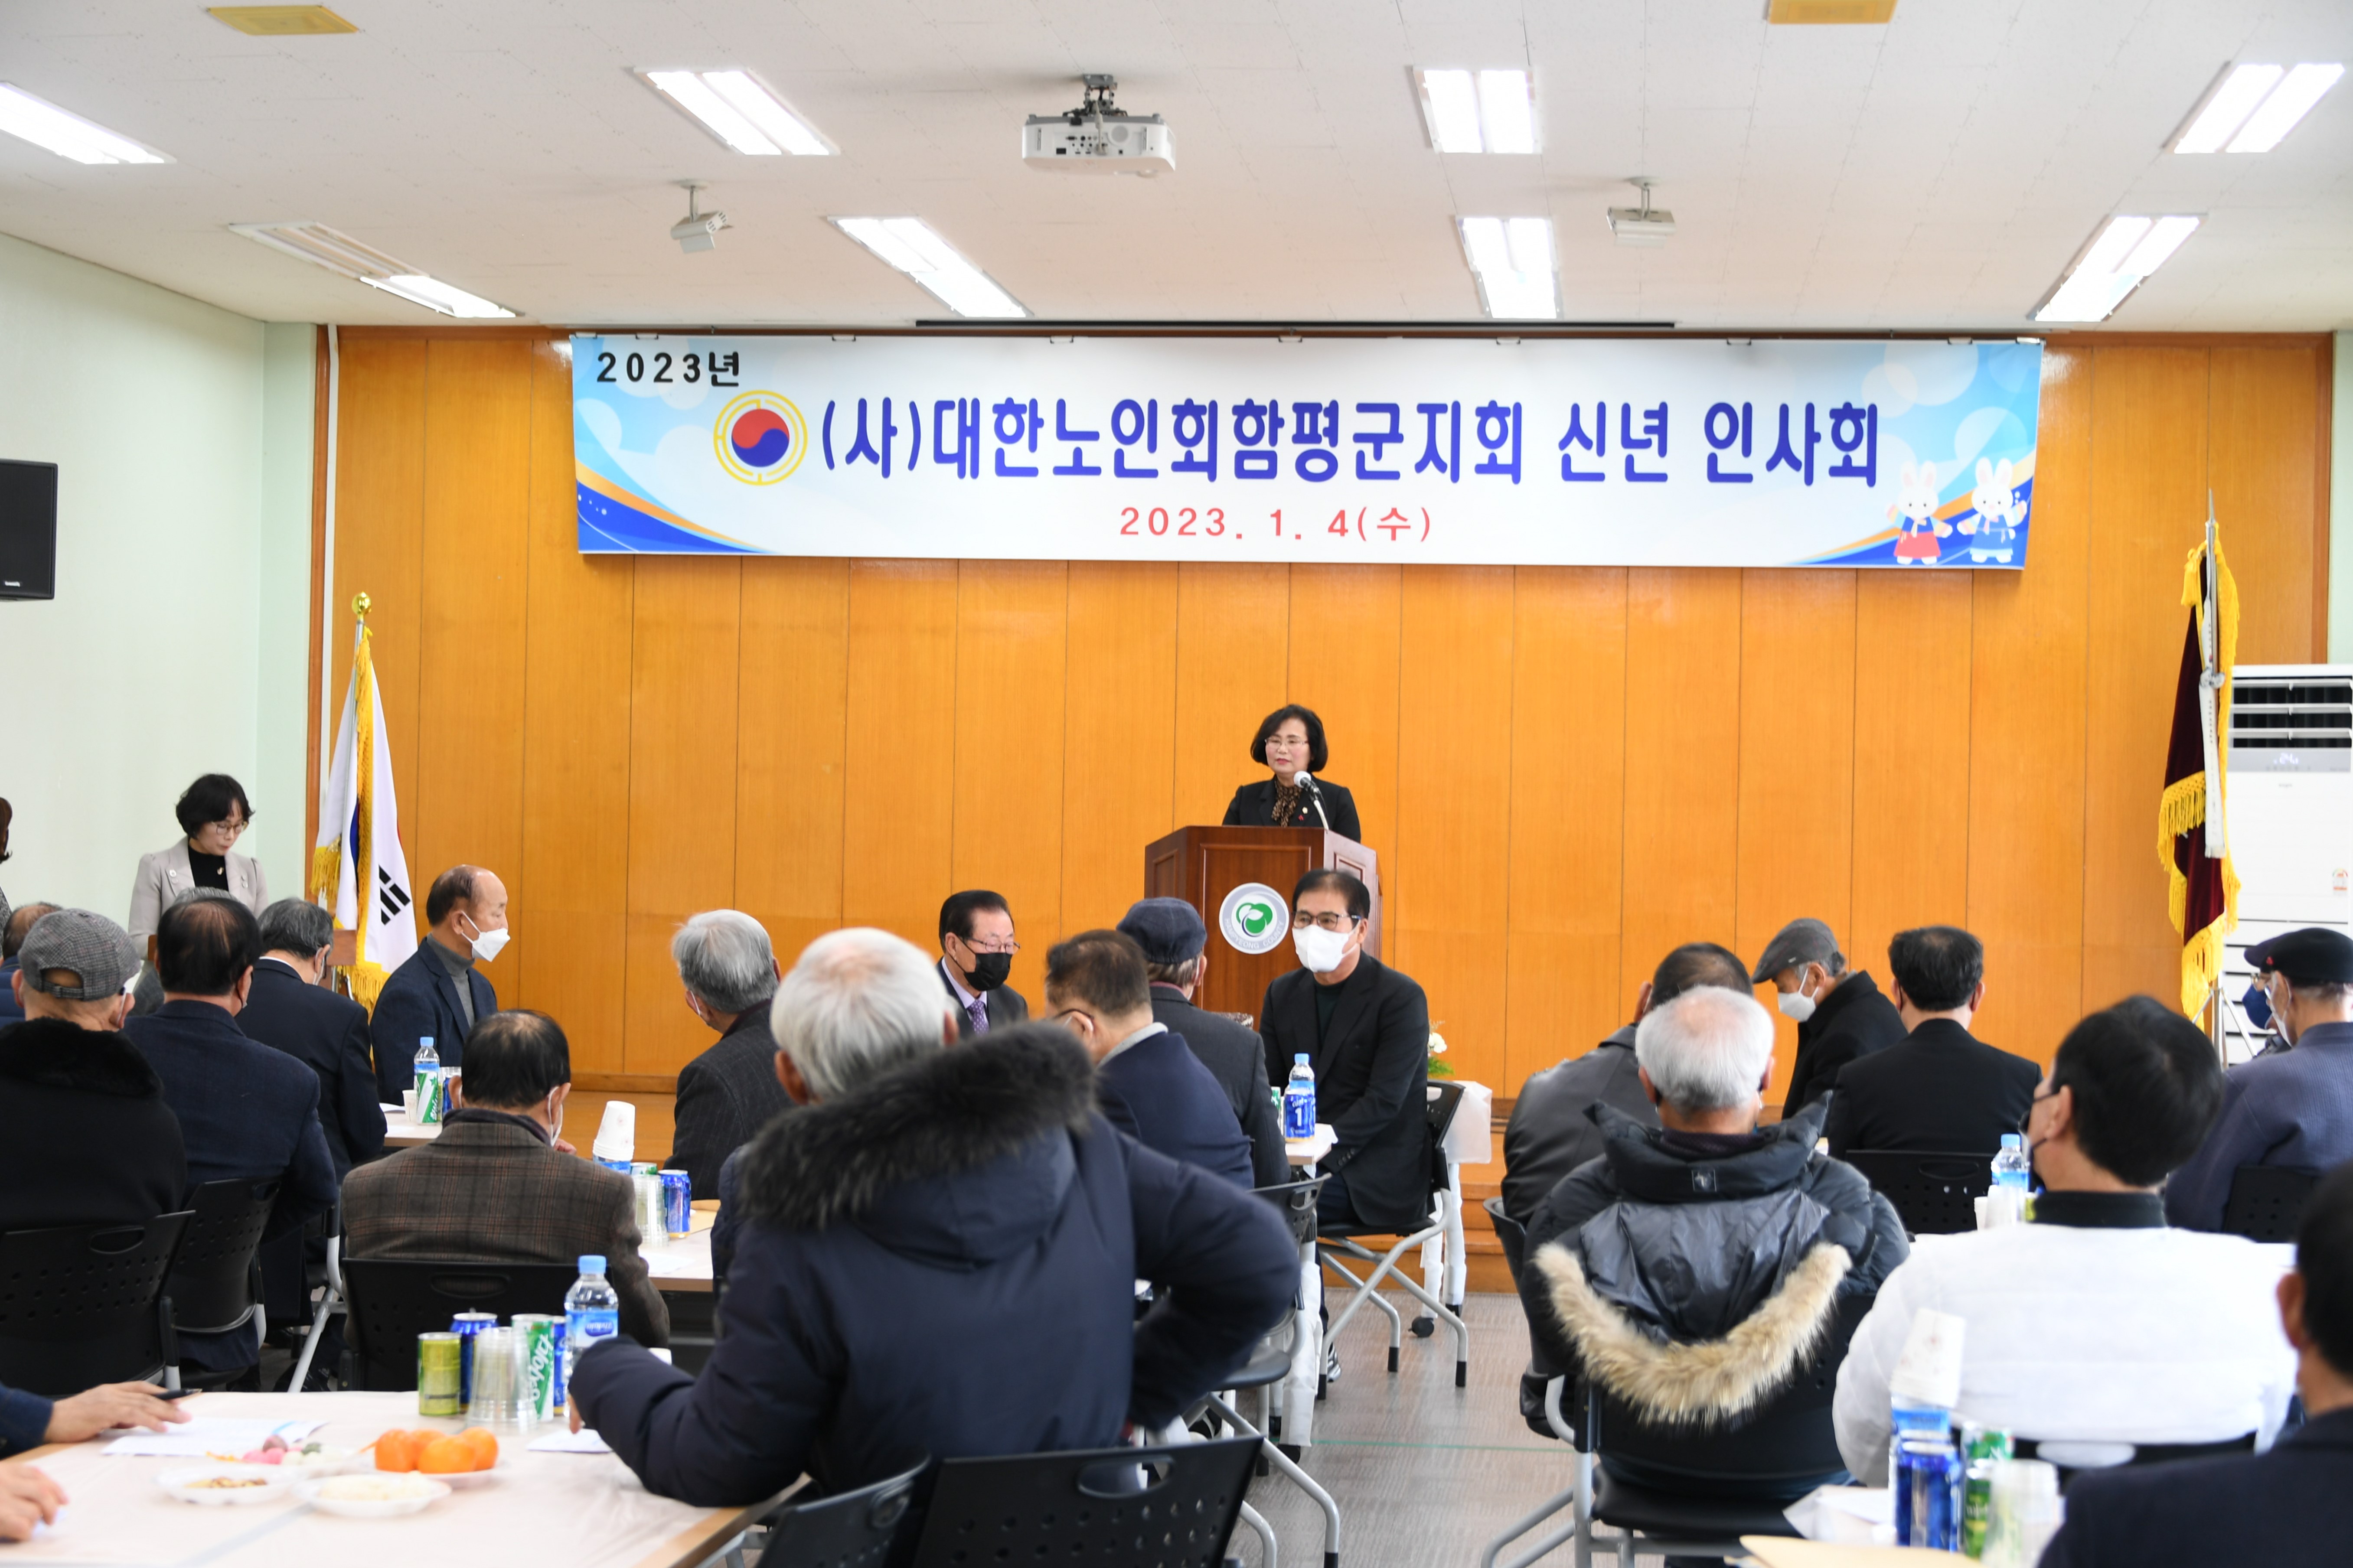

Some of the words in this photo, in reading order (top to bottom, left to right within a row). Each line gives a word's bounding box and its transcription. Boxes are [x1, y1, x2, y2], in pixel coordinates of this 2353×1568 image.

[597, 351, 739, 387] 2023년
[822, 396, 1523, 486] (사)대한노인회함평군지회
[1557, 400, 1669, 483] 신년
[1704, 401, 1879, 489] 인사회
[1119, 506, 1243, 540] 2023.
[1270, 508, 1302, 541] 1.
[1327, 506, 1431, 542] 4(수)
